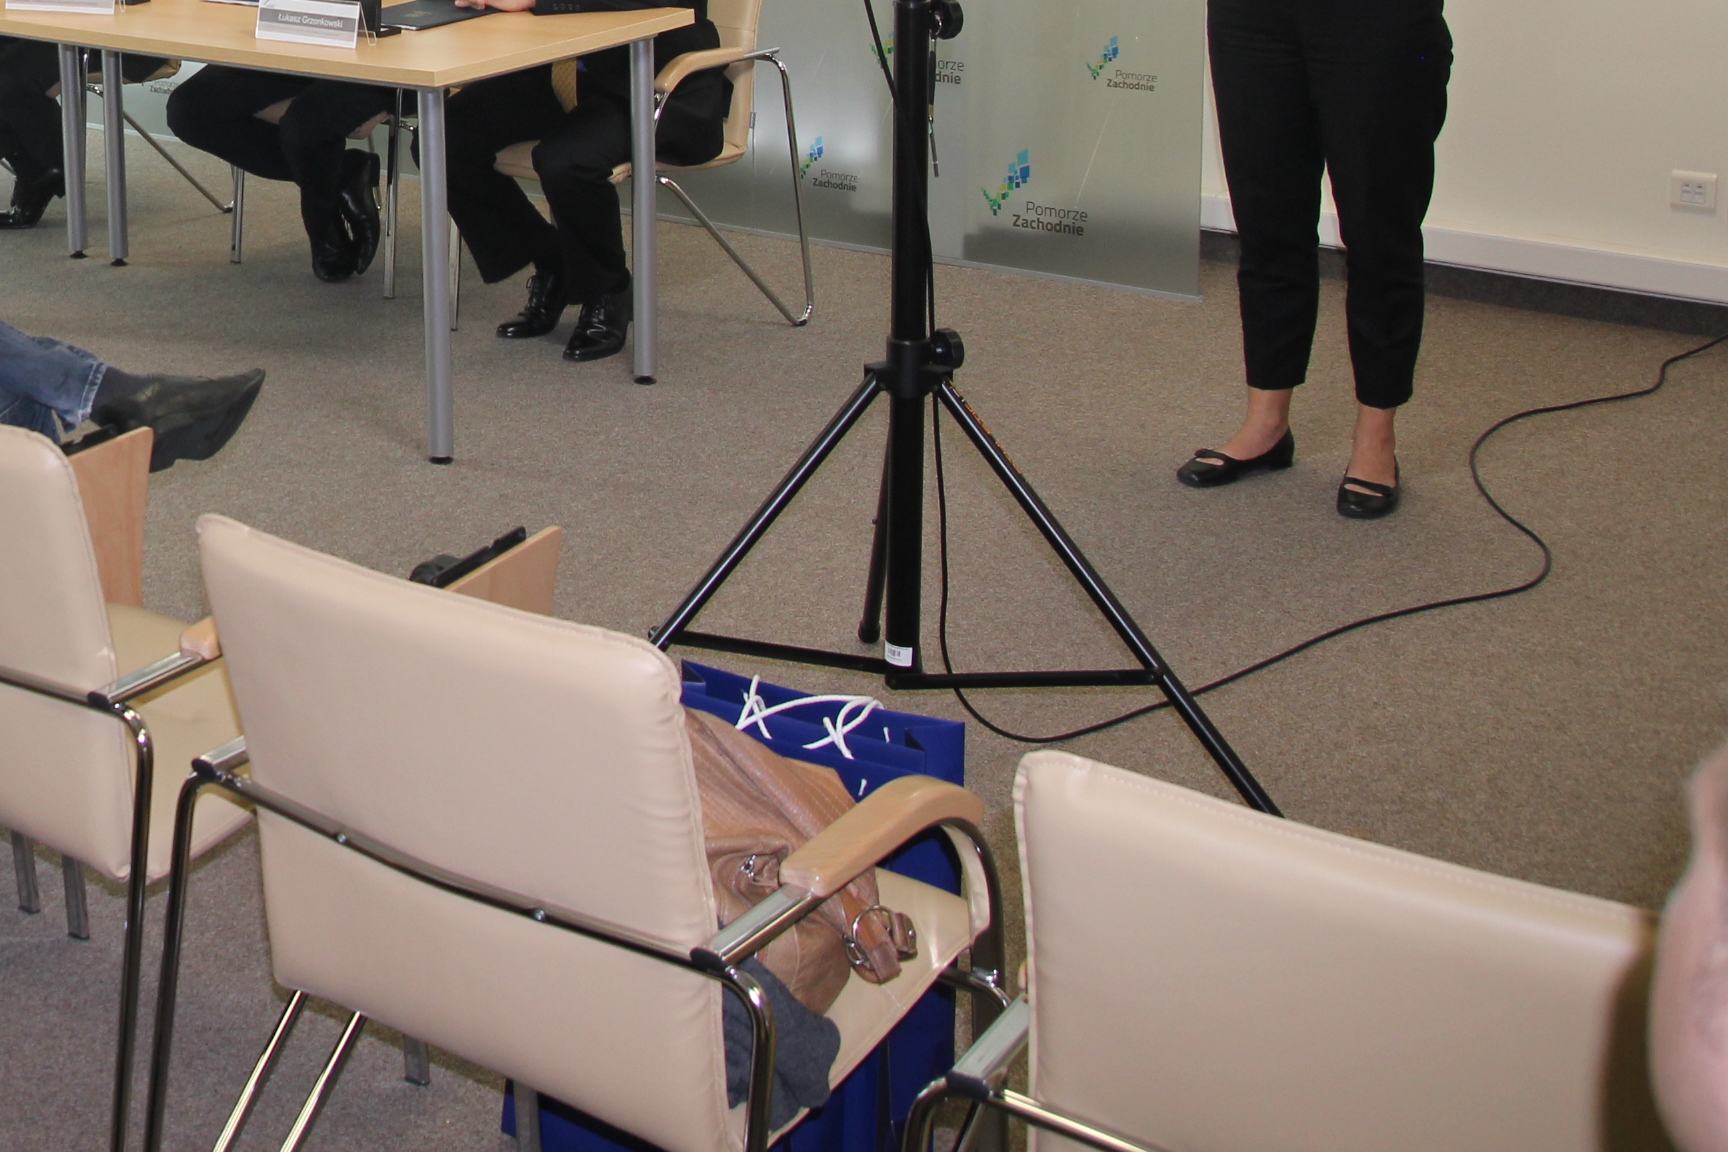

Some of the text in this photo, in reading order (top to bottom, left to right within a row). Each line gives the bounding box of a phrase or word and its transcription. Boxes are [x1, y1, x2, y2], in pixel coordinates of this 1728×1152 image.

[277, 13, 301, 24] Łukasz
[1115, 70, 1158, 83] Pomorze
[1106, 79, 1155, 92] Zachodnie
[821, 169, 858, 182] Pomorze
[812, 178, 857, 191] Zachodnie
[1025, 201, 1088, 223] Pomorze
[1012, 214, 1084, 236] Zachodnie
